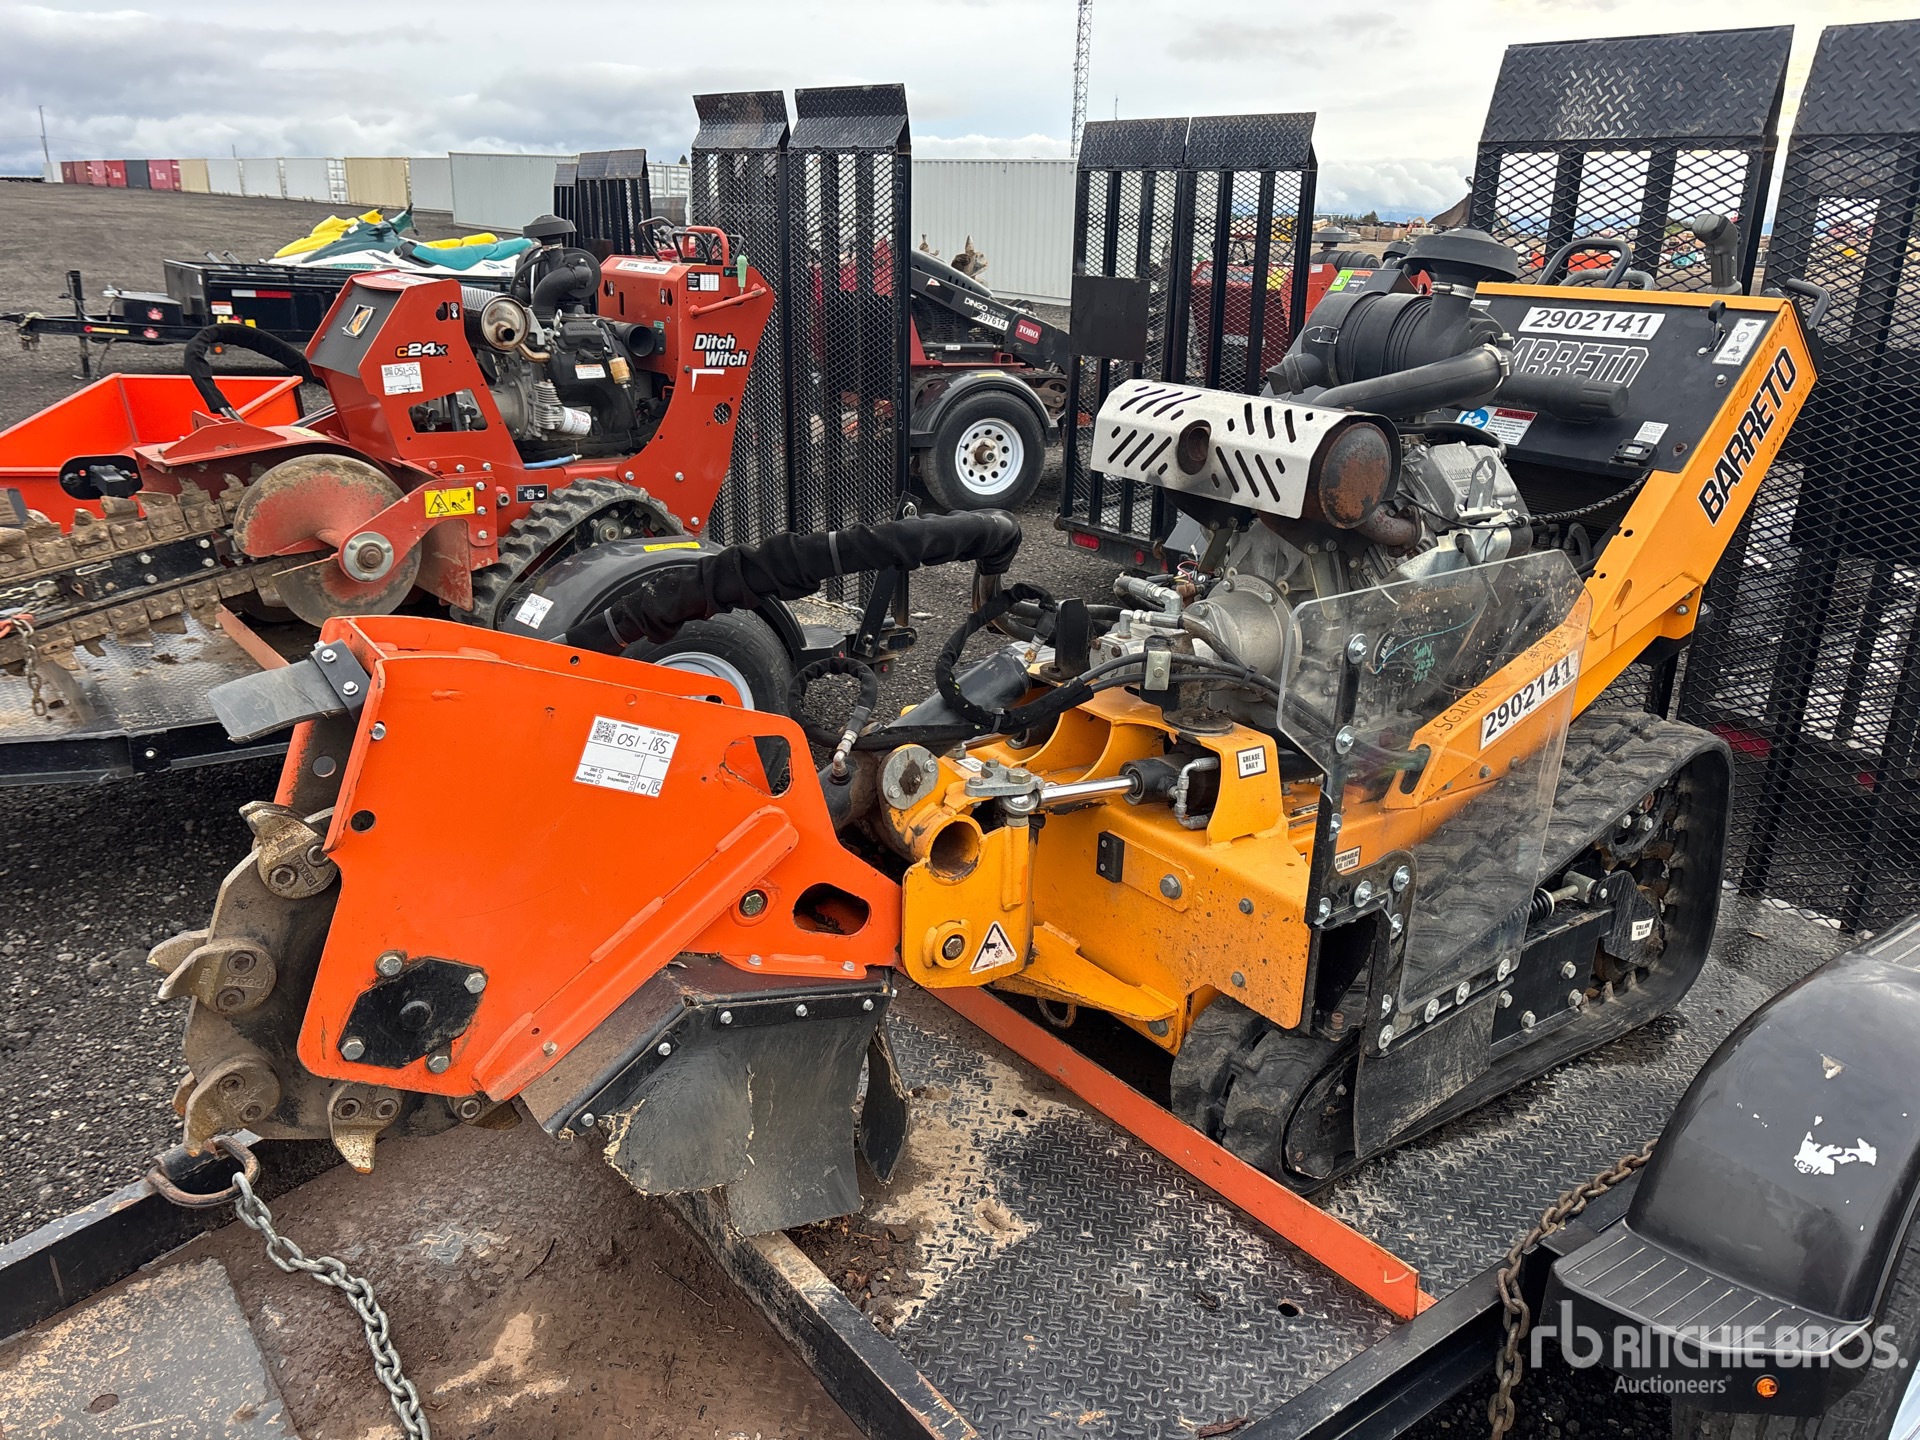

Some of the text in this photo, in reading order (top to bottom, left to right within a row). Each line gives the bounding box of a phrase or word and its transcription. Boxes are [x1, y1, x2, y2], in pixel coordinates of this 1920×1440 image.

[963, 297, 989, 312] DINGO
[1529, 309, 1653, 334] 2902141
[1018, 324, 1039, 340] TORO
[694, 333, 736, 350] Ditch
[705, 350, 747, 367] Witch
[1512, 337, 1650, 389] ARRETO
[1697, 346, 1797, 527] BARRETO
[1484, 655, 1573, 739] 2902141
[1242, 752, 1261, 763] GREASE
[1245, 761, 1259, 770] DAILY
[607, 776, 630, 785] Inspection
